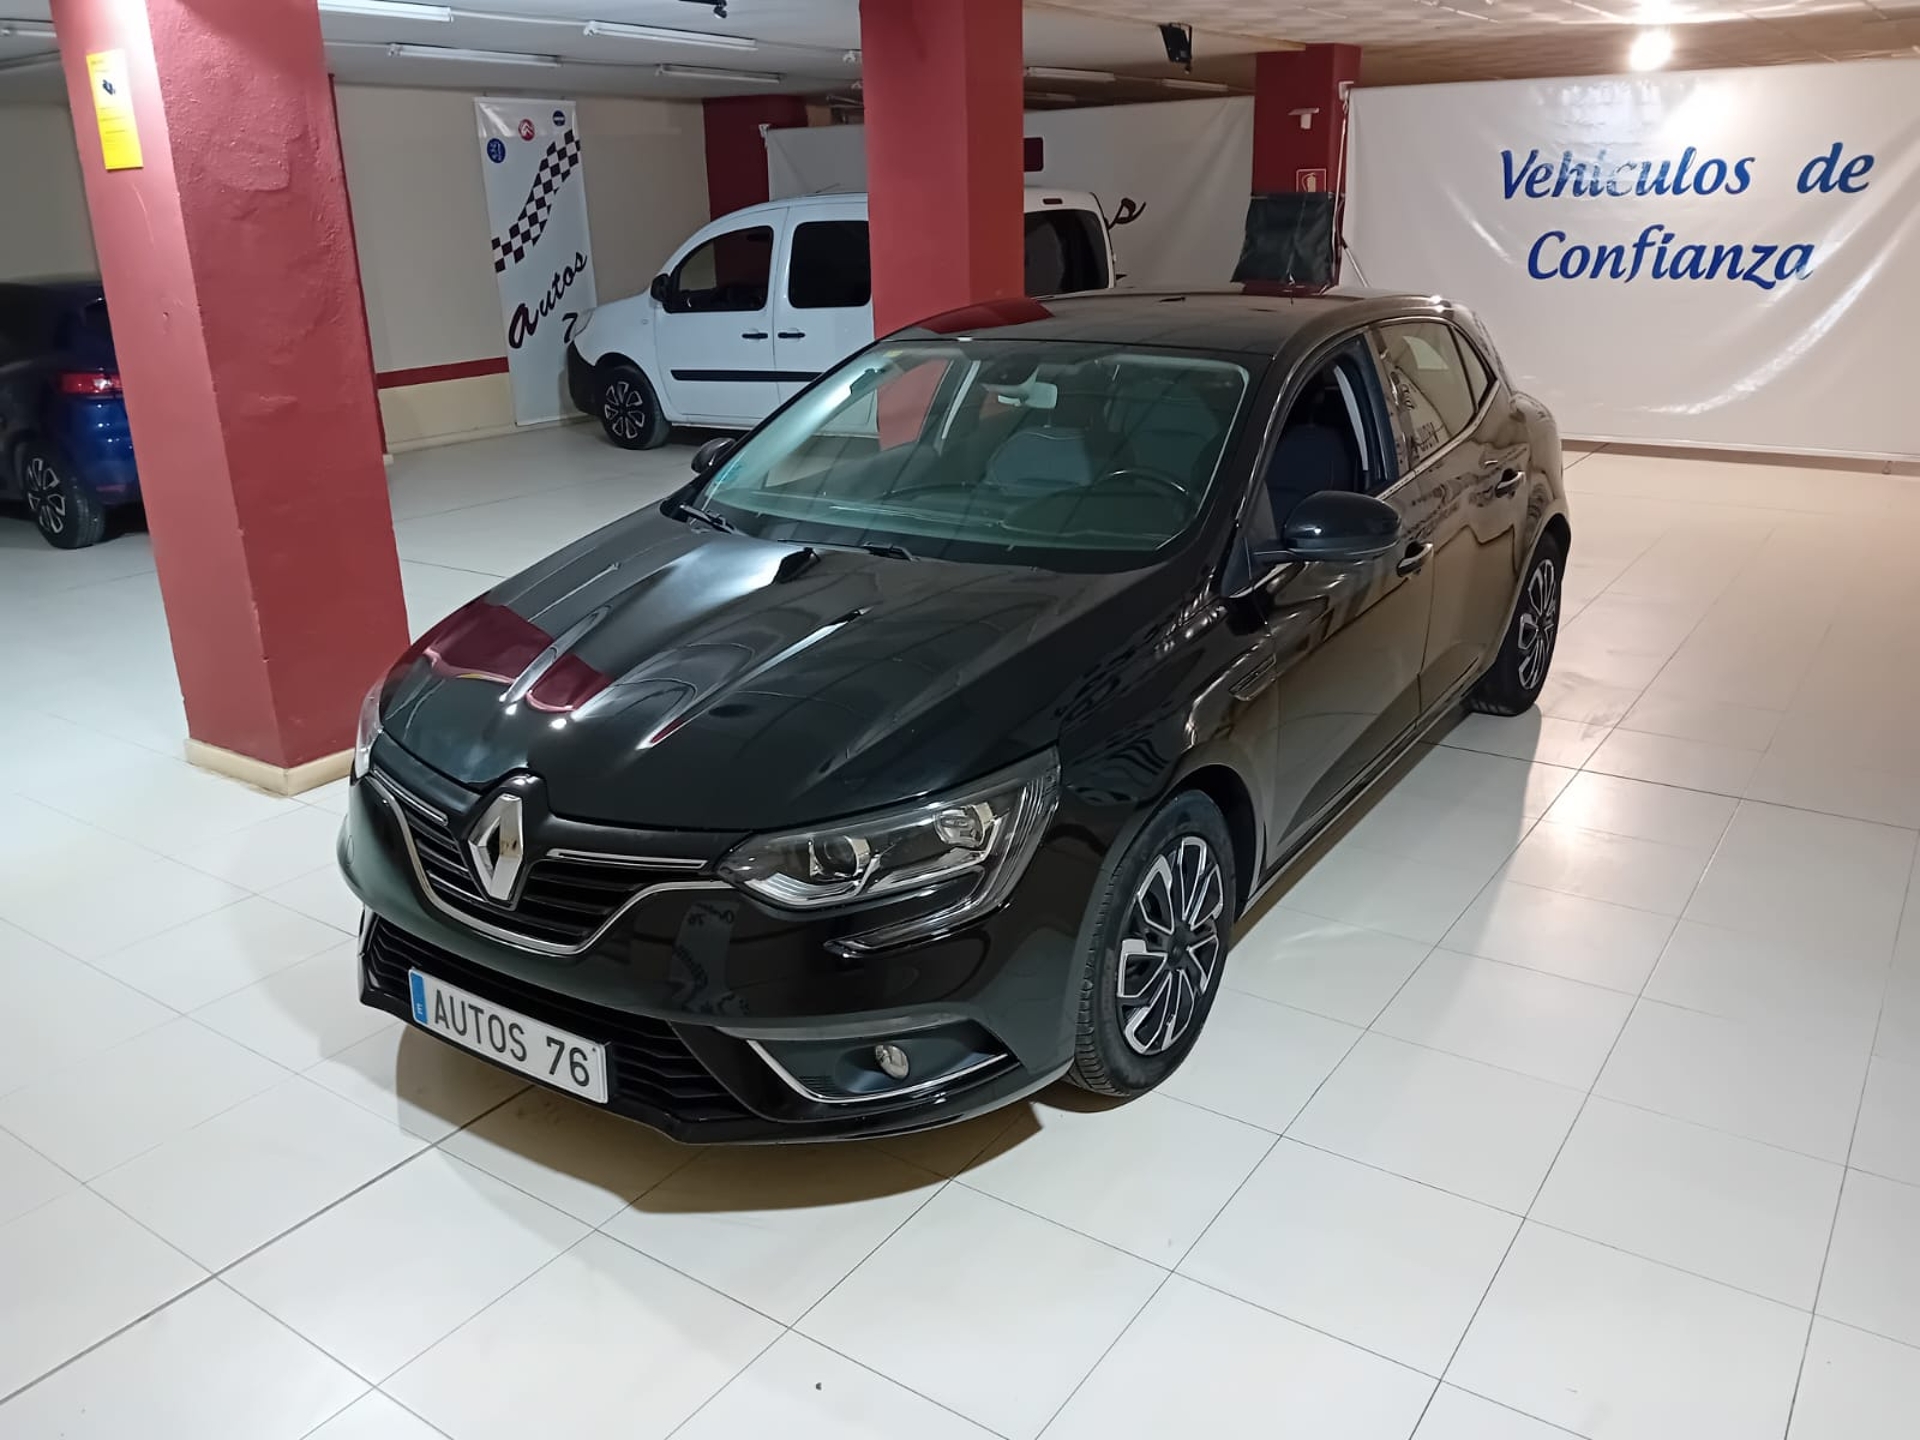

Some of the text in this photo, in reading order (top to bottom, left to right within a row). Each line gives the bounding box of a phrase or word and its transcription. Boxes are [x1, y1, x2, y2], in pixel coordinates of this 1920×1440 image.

[1797, 142, 1875, 194] de
[1528, 223, 1816, 291] Confianza
[508, 251, 588, 349] Autos
[562, 312, 578, 344] 7
[434, 988, 591, 1087] AUTOS 76
